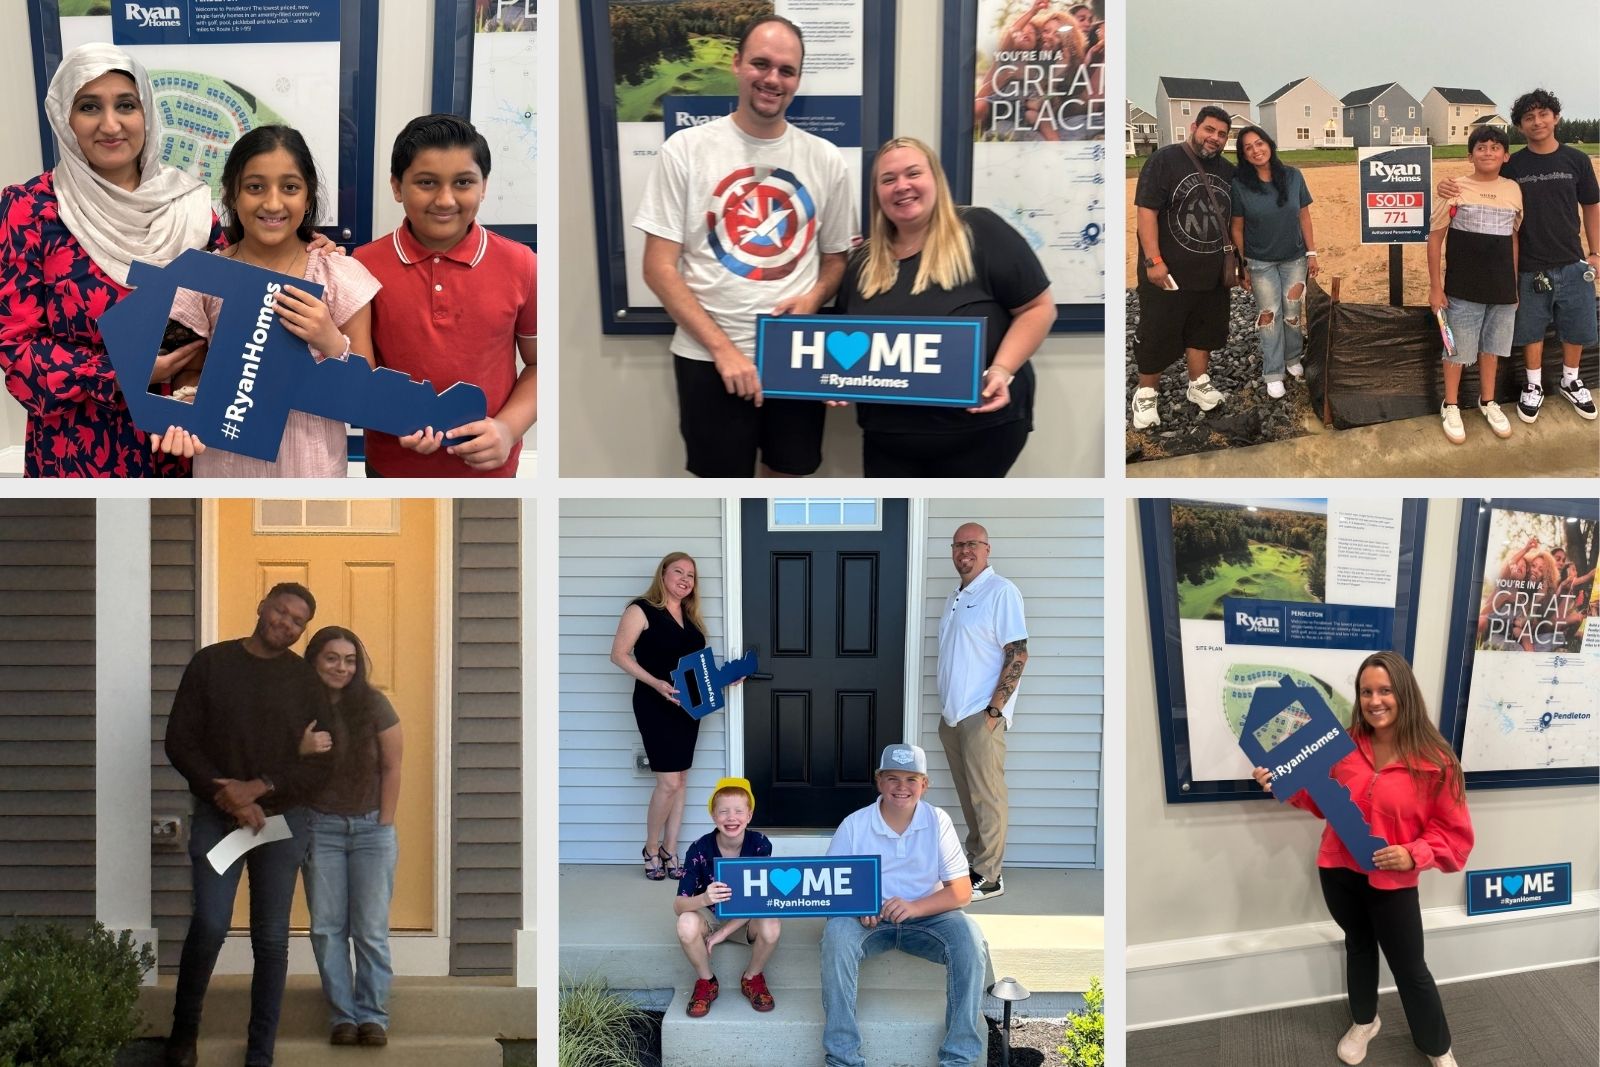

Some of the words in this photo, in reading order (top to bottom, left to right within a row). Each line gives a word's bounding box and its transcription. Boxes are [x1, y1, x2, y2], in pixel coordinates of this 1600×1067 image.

[125, 3, 180, 27] Ryan
[149, 19, 181, 27] Homes
[994, 50, 1037, 61] YOU'RE
[1039, 50, 1052, 61] IN
[1054, 50, 1063, 61] A
[992, 64, 1105, 97] GREAT
[991, 99, 1105, 131] PLACE
[1370, 161, 1421, 182] Ryan
[1376, 194, 1415, 207] SOLD
[1385, 212, 1408, 223] 771
[221, 282, 281, 440] #RyanHomes
[820, 374, 909, 388] #RyanHomes
[1496, 579, 1525, 588] YOU'RE
[1527, 581, 1536, 589] IN
[1492, 590, 1576, 618] GREAT
[1291, 610, 1323, 618] PENDLETON
[1236, 612, 1279, 631] Ryan
[1489, 618, 1568, 644] PLACE.
[1553, 712, 1591, 720] Pendleton
[1271, 727, 1339, 781] #RyanHomes
[766, 898, 831, 909] #RyanHomes
[1500, 895, 1542, 905] #RyanHomes
